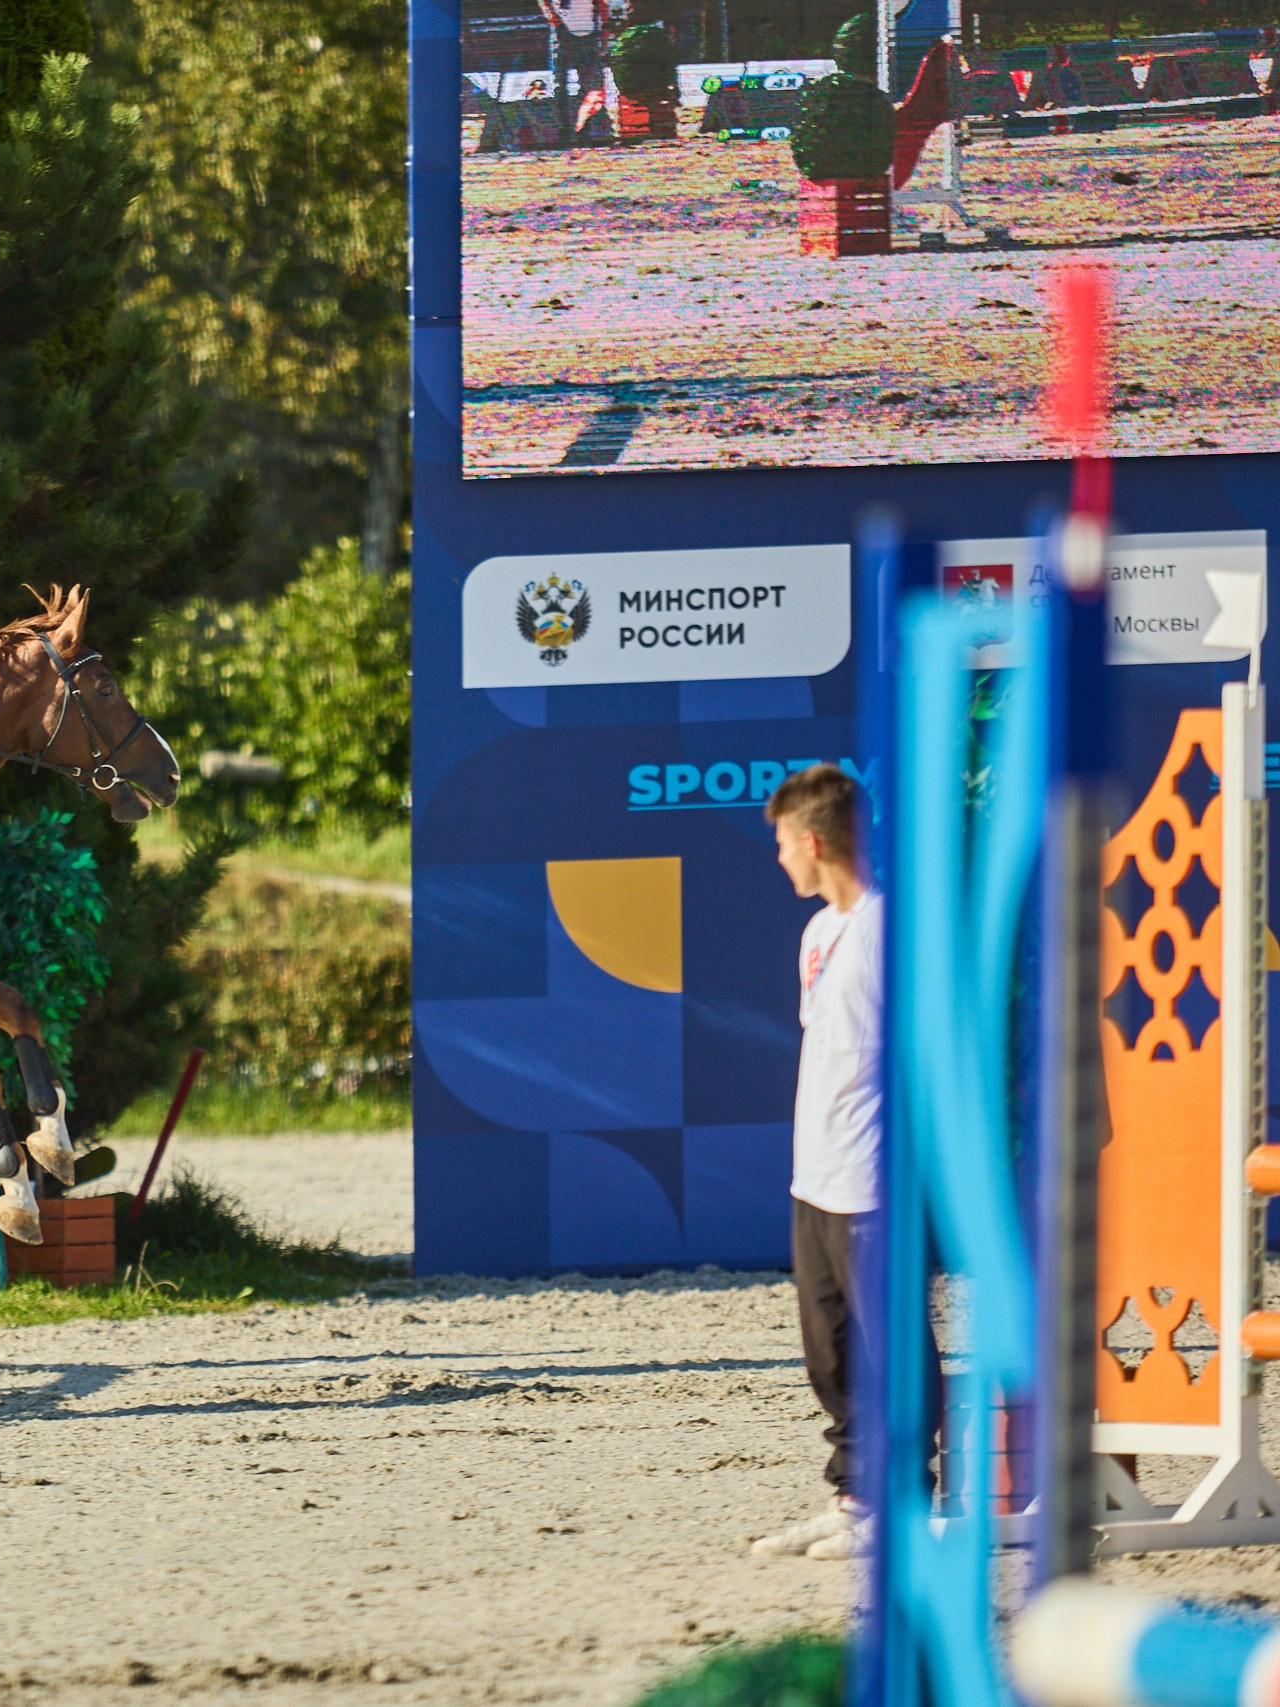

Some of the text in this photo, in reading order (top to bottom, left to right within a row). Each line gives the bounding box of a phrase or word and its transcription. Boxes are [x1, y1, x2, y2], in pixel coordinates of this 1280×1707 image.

[1029, 564, 1177, 586] Деамент
[619, 585, 787, 613] МИНСПОРТ
[619, 623, 745, 649] РОССИИ
[1113, 616, 1200, 634] Москвы
